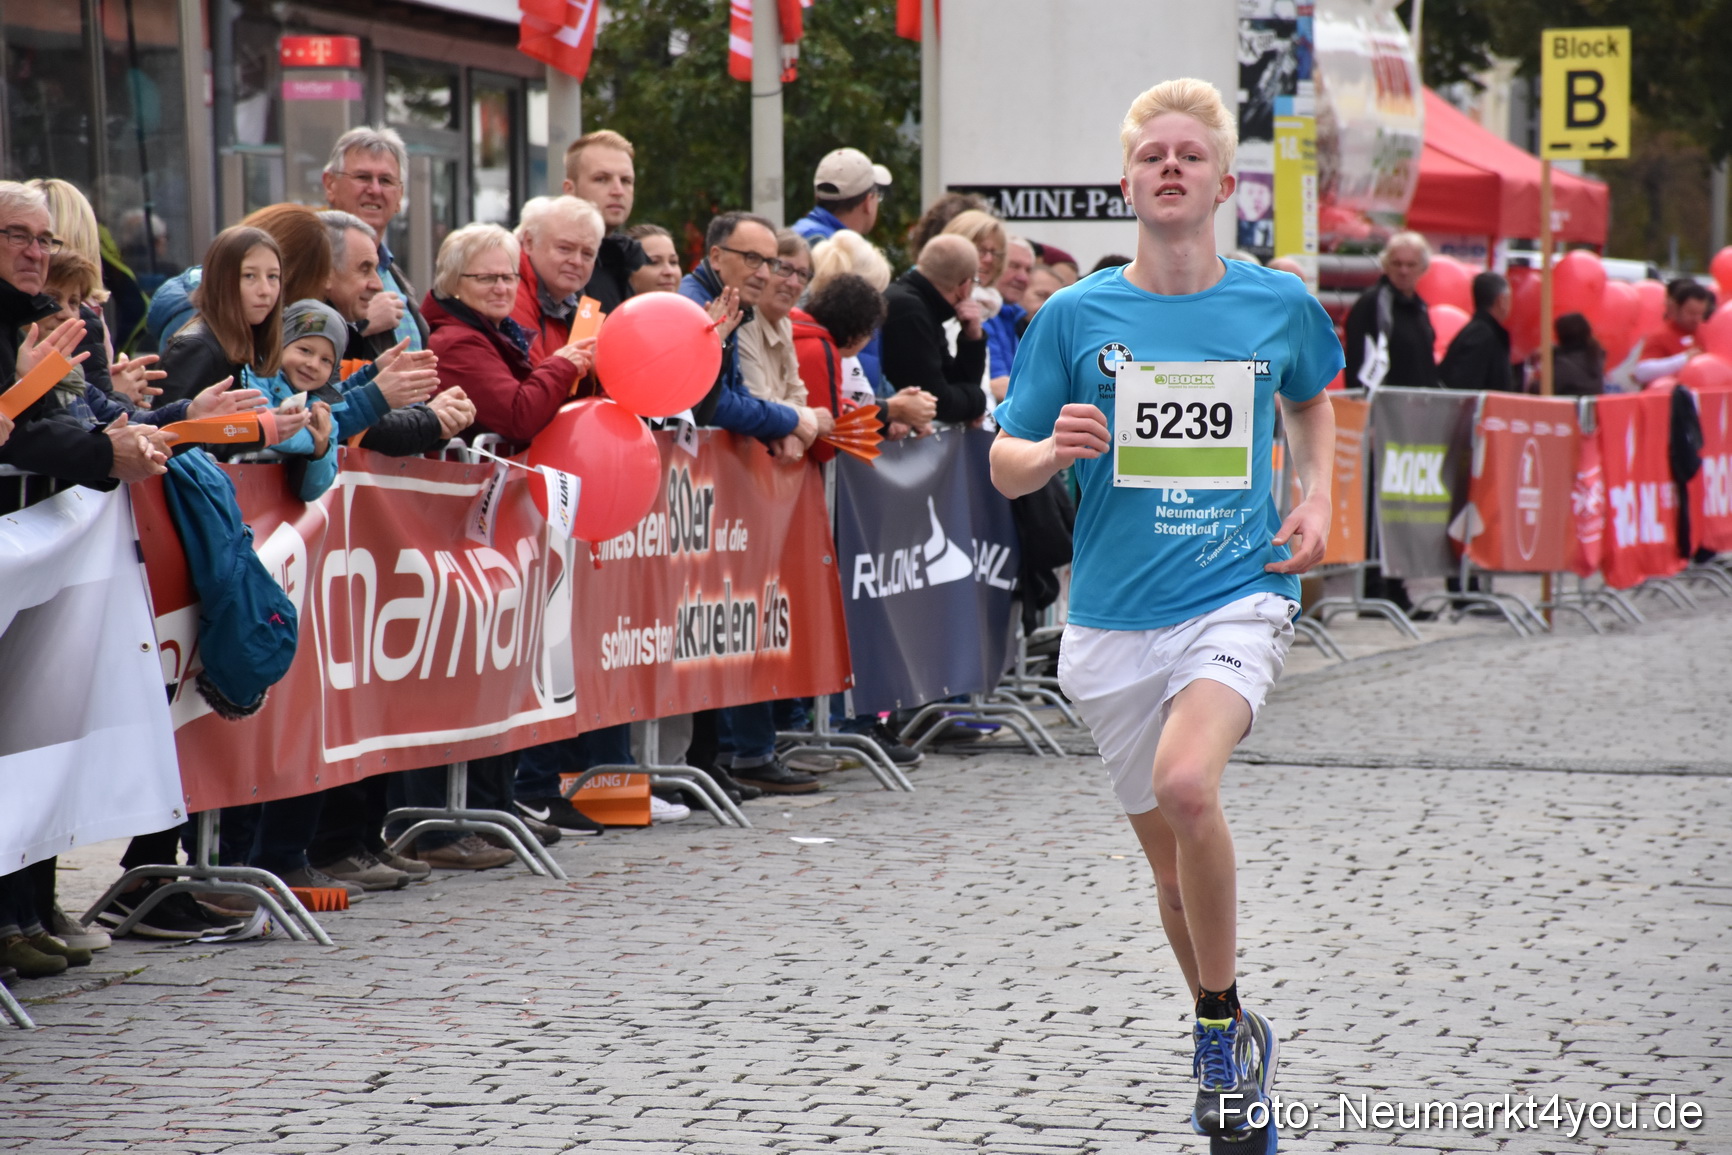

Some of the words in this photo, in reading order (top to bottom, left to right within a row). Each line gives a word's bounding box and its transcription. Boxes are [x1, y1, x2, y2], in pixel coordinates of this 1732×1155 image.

[1553, 37, 1619, 59] Block
[1565, 69, 1607, 129] B
[1101, 343, 1130, 356] BMW
[1168, 374, 1215, 385] BOCK
[1135, 402, 1233, 439] 5239
[1122, 433, 1128, 441] S
[1382, 449, 1446, 495] BOCK
[668, 467, 714, 553] 80er
[1155, 505, 1236, 519] Neumarkter
[729, 519, 747, 551] die
[1154, 522, 1219, 536] Stadtlauf
[1200, 558, 1210, 568] 17.
[1207, 535, 1233, 562] September
[601, 615, 673, 671] schönsten
[1212, 654, 1242, 668] JAKO
